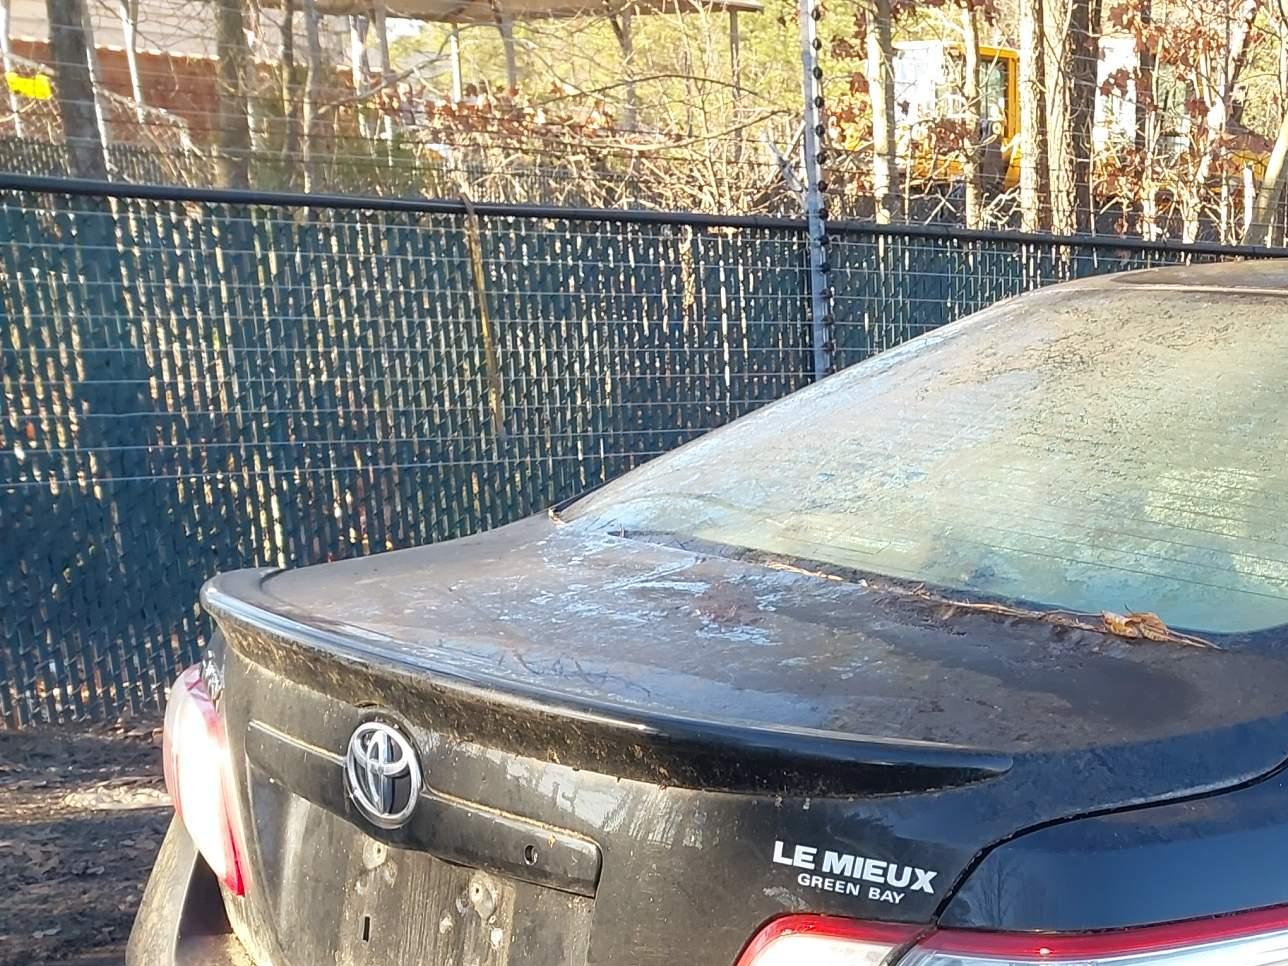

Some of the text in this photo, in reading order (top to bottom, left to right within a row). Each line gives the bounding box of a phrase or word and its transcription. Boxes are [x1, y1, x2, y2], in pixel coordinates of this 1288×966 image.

[772, 840, 938, 894] LE MIEUX
[797, 872, 906, 905] GREEN BAY
